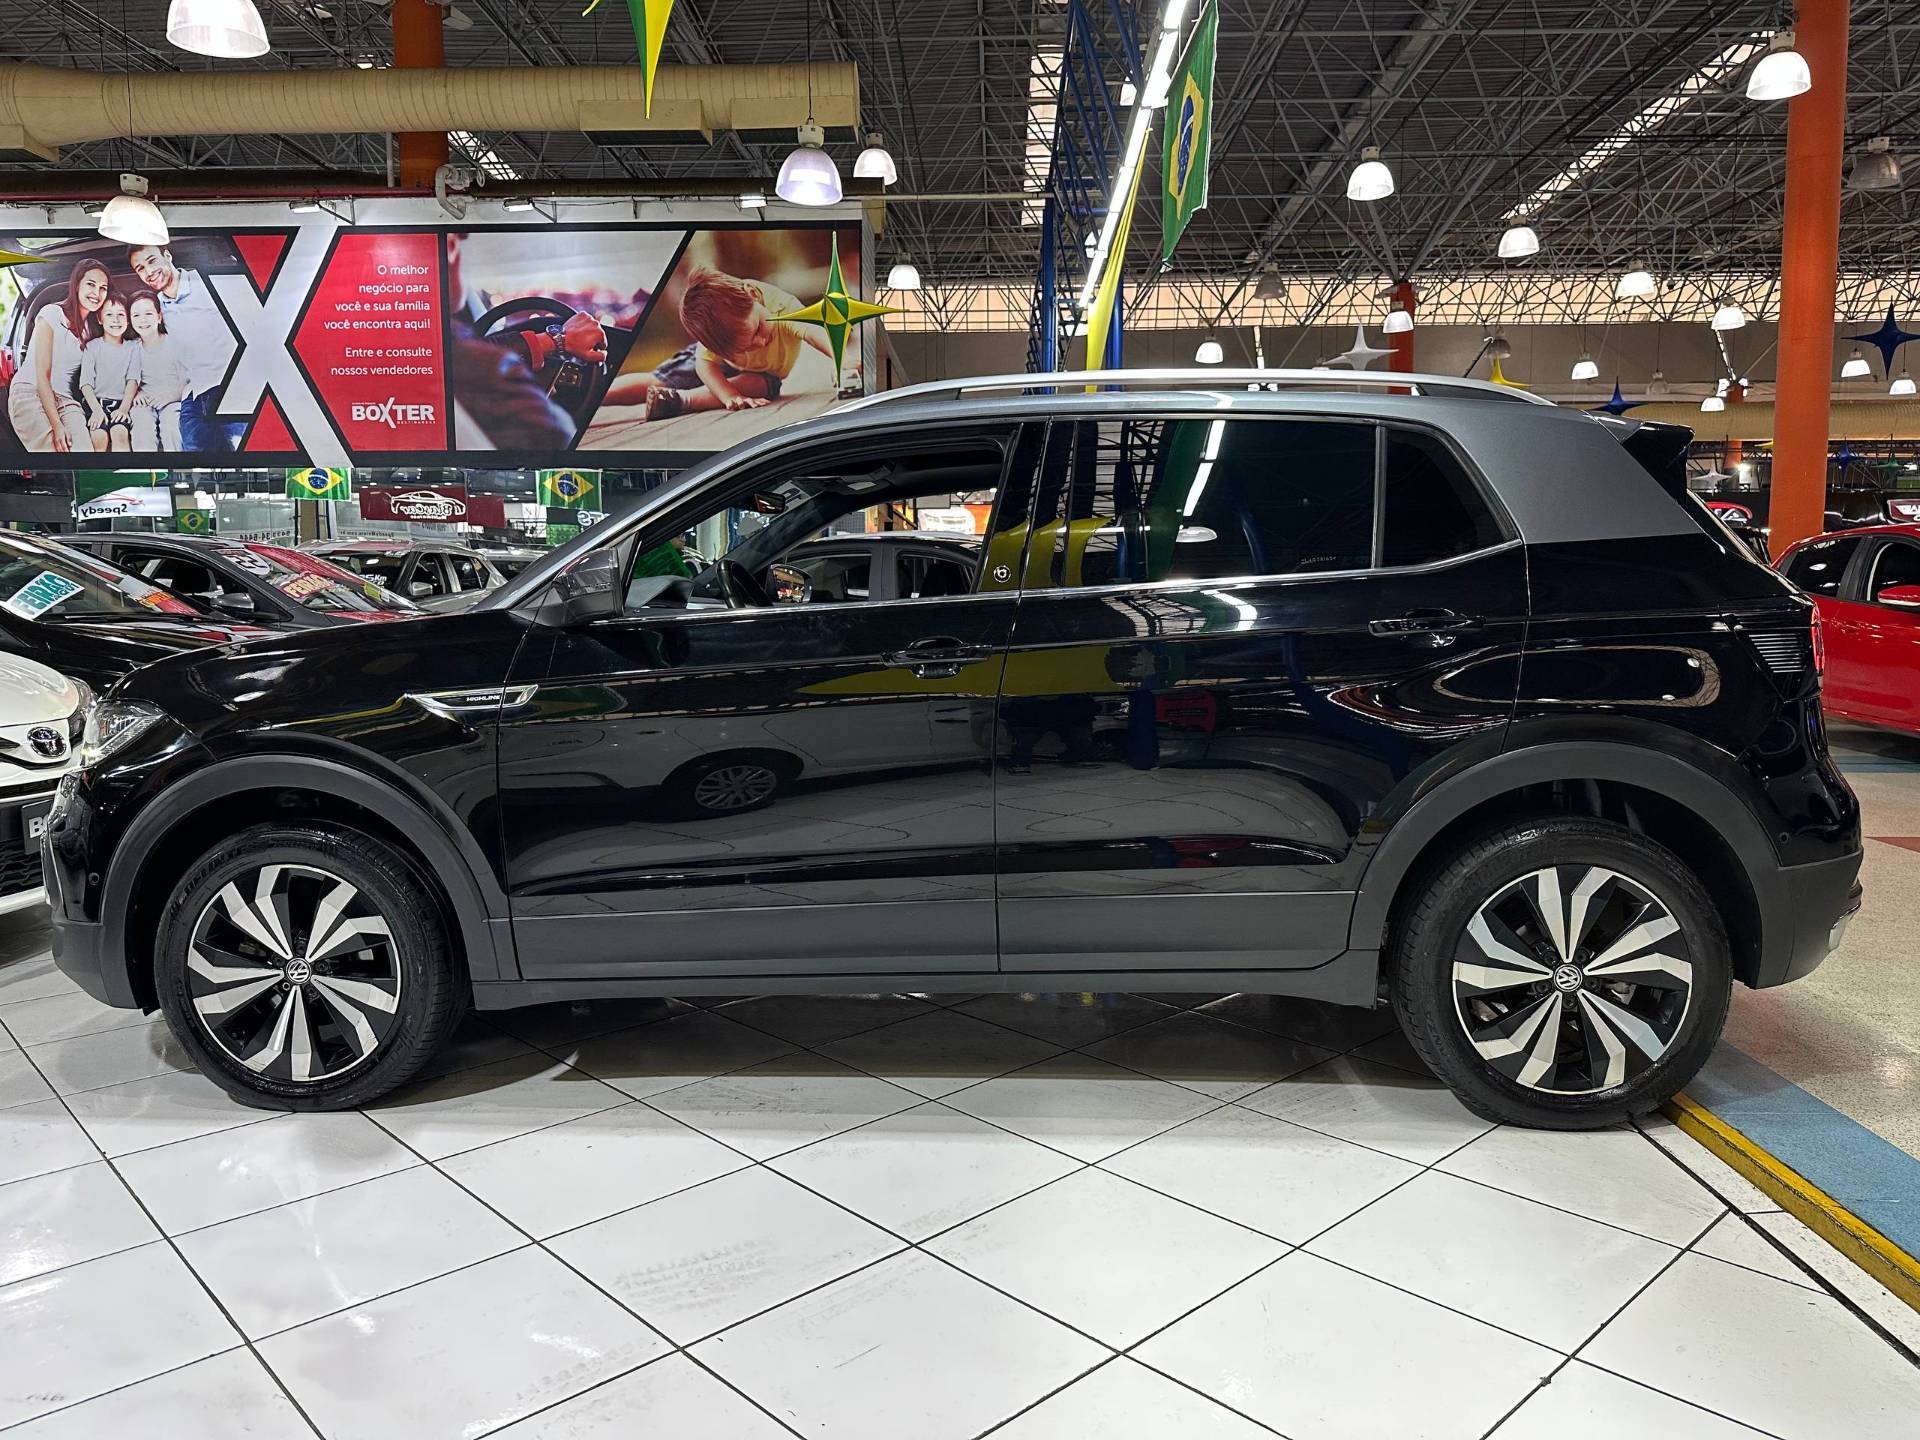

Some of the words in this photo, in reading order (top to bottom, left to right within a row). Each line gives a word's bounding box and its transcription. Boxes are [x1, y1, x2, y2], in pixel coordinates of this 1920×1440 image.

[377, 265, 388, 275] O
[390, 264, 430, 275] melhor
[358, 283, 403, 296] negócio
[406, 284, 430, 295] para
[335, 301, 362, 311] você
[363, 303, 371, 311] e
[373, 303, 392, 311] sua
[394, 300, 431, 311] família
[324, 319, 351, 330] você
[352, 320, 402, 330] encontra
[404, 318, 431, 331] aqui!
[345, 347, 375, 358] Entre
[376, 349, 384, 357] e
[385, 346, 433, 357] consulte
[330, 367, 369, 376] nossos
[370, 364, 434, 375] vendedores
[351, 396, 436, 429] BOXTER
